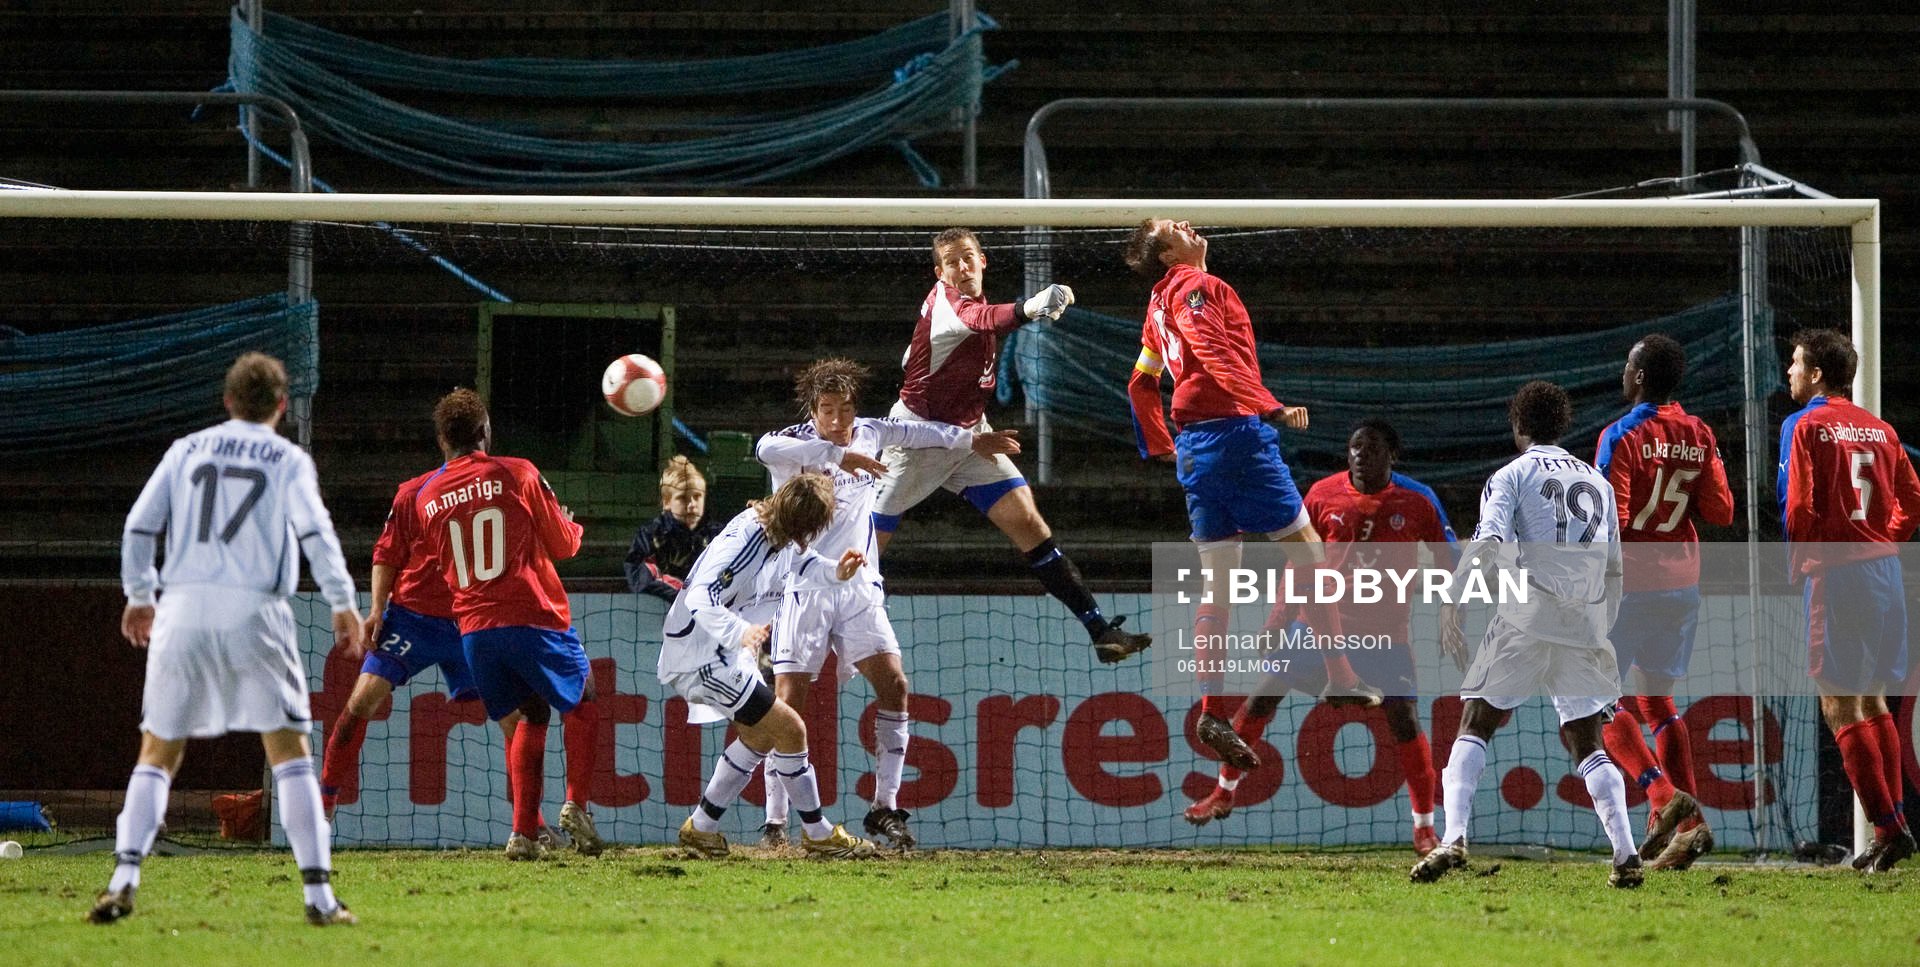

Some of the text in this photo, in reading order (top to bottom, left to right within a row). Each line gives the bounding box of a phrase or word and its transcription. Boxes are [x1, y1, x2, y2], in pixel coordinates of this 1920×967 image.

[1818, 422, 1888, 444] a.jakobsson
[190, 463, 268, 545] 17
[424, 477, 503, 519] m.mariga
[1540, 478, 1604, 549] 19
[1631, 467, 1701, 533] 15
[1849, 450, 1875, 521] 5
[448, 507, 506, 589] 10
[1361, 520, 1374, 541] 3
[379, 633, 412, 657] 23
